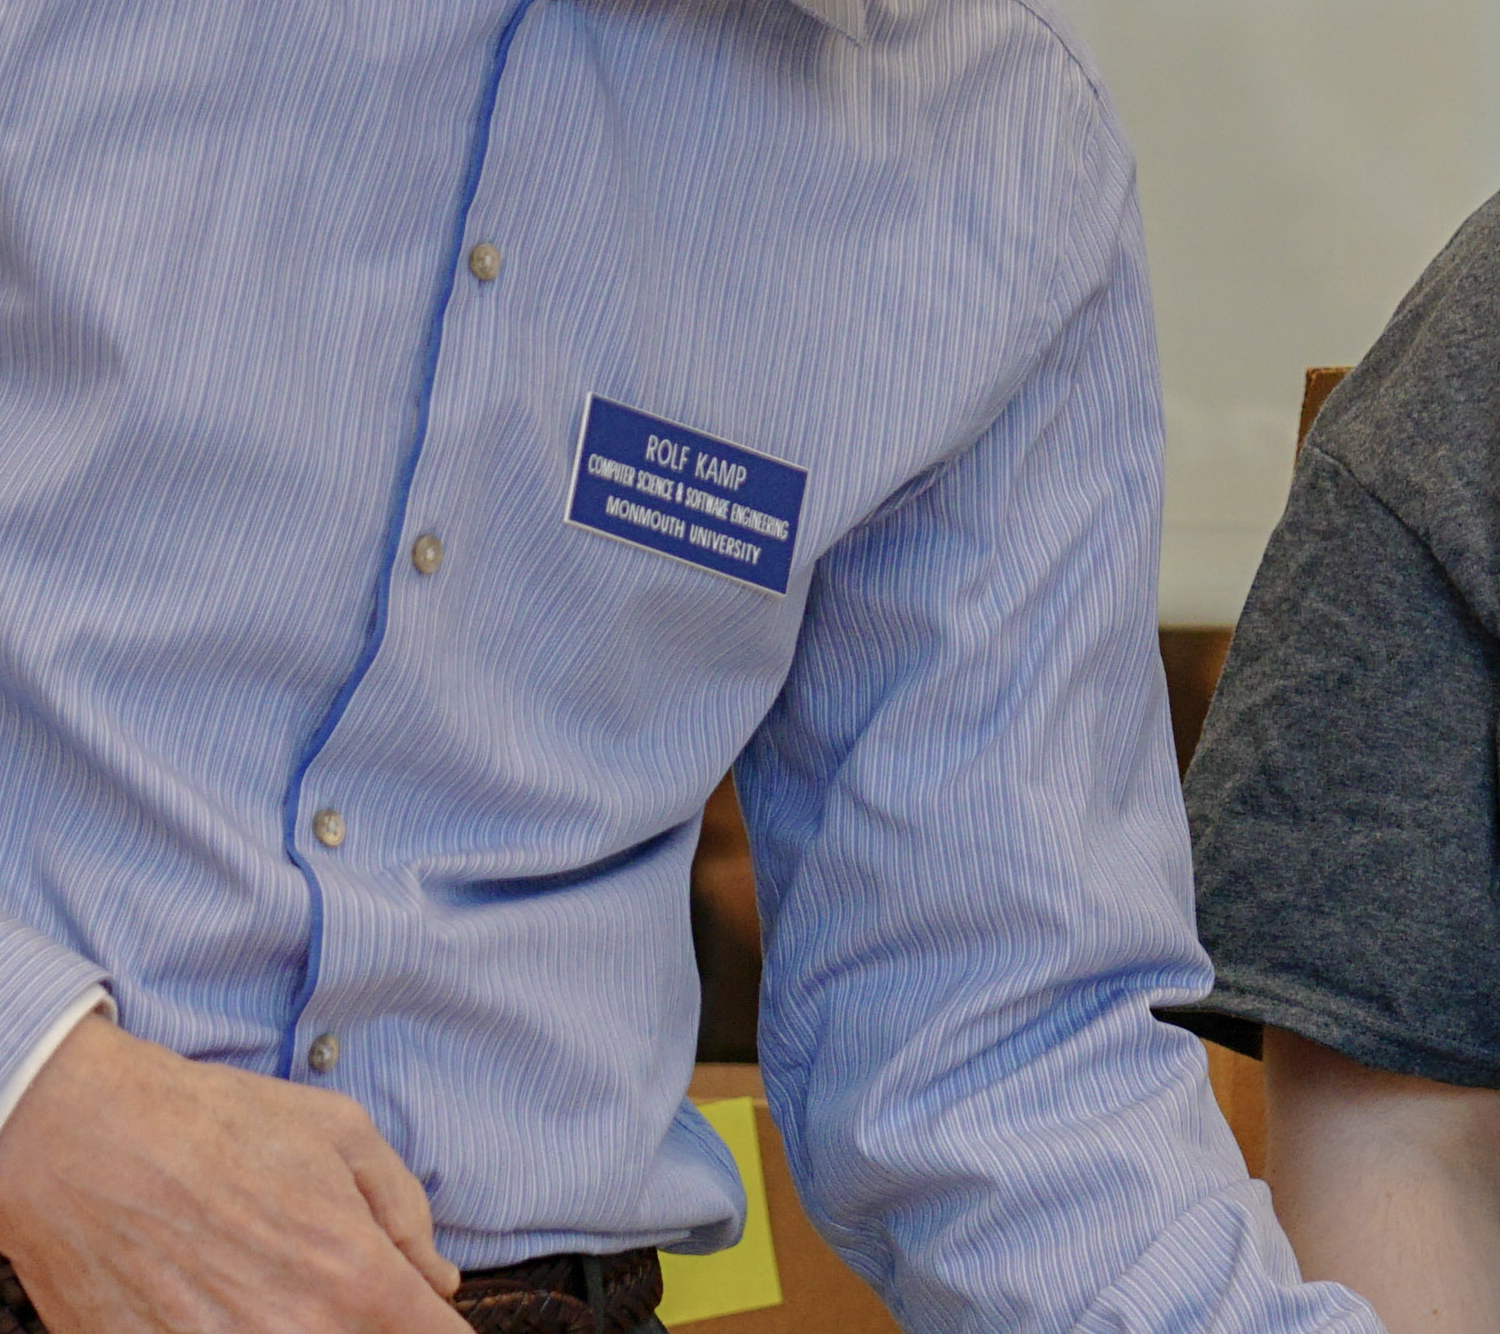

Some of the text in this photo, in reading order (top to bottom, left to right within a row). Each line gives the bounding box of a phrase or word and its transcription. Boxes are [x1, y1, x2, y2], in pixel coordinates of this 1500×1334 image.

[588, 453, 634, 485] COMPUTER
[636, 468, 674, 501] SCIENCE
[685, 487, 730, 520] SOFTWARE
[730, 501, 789, 541] ENGINEERING
[645, 435, 747, 491] ROLF KAMP
[605, 495, 761, 565] MONMOUTH UNIVERSITY
